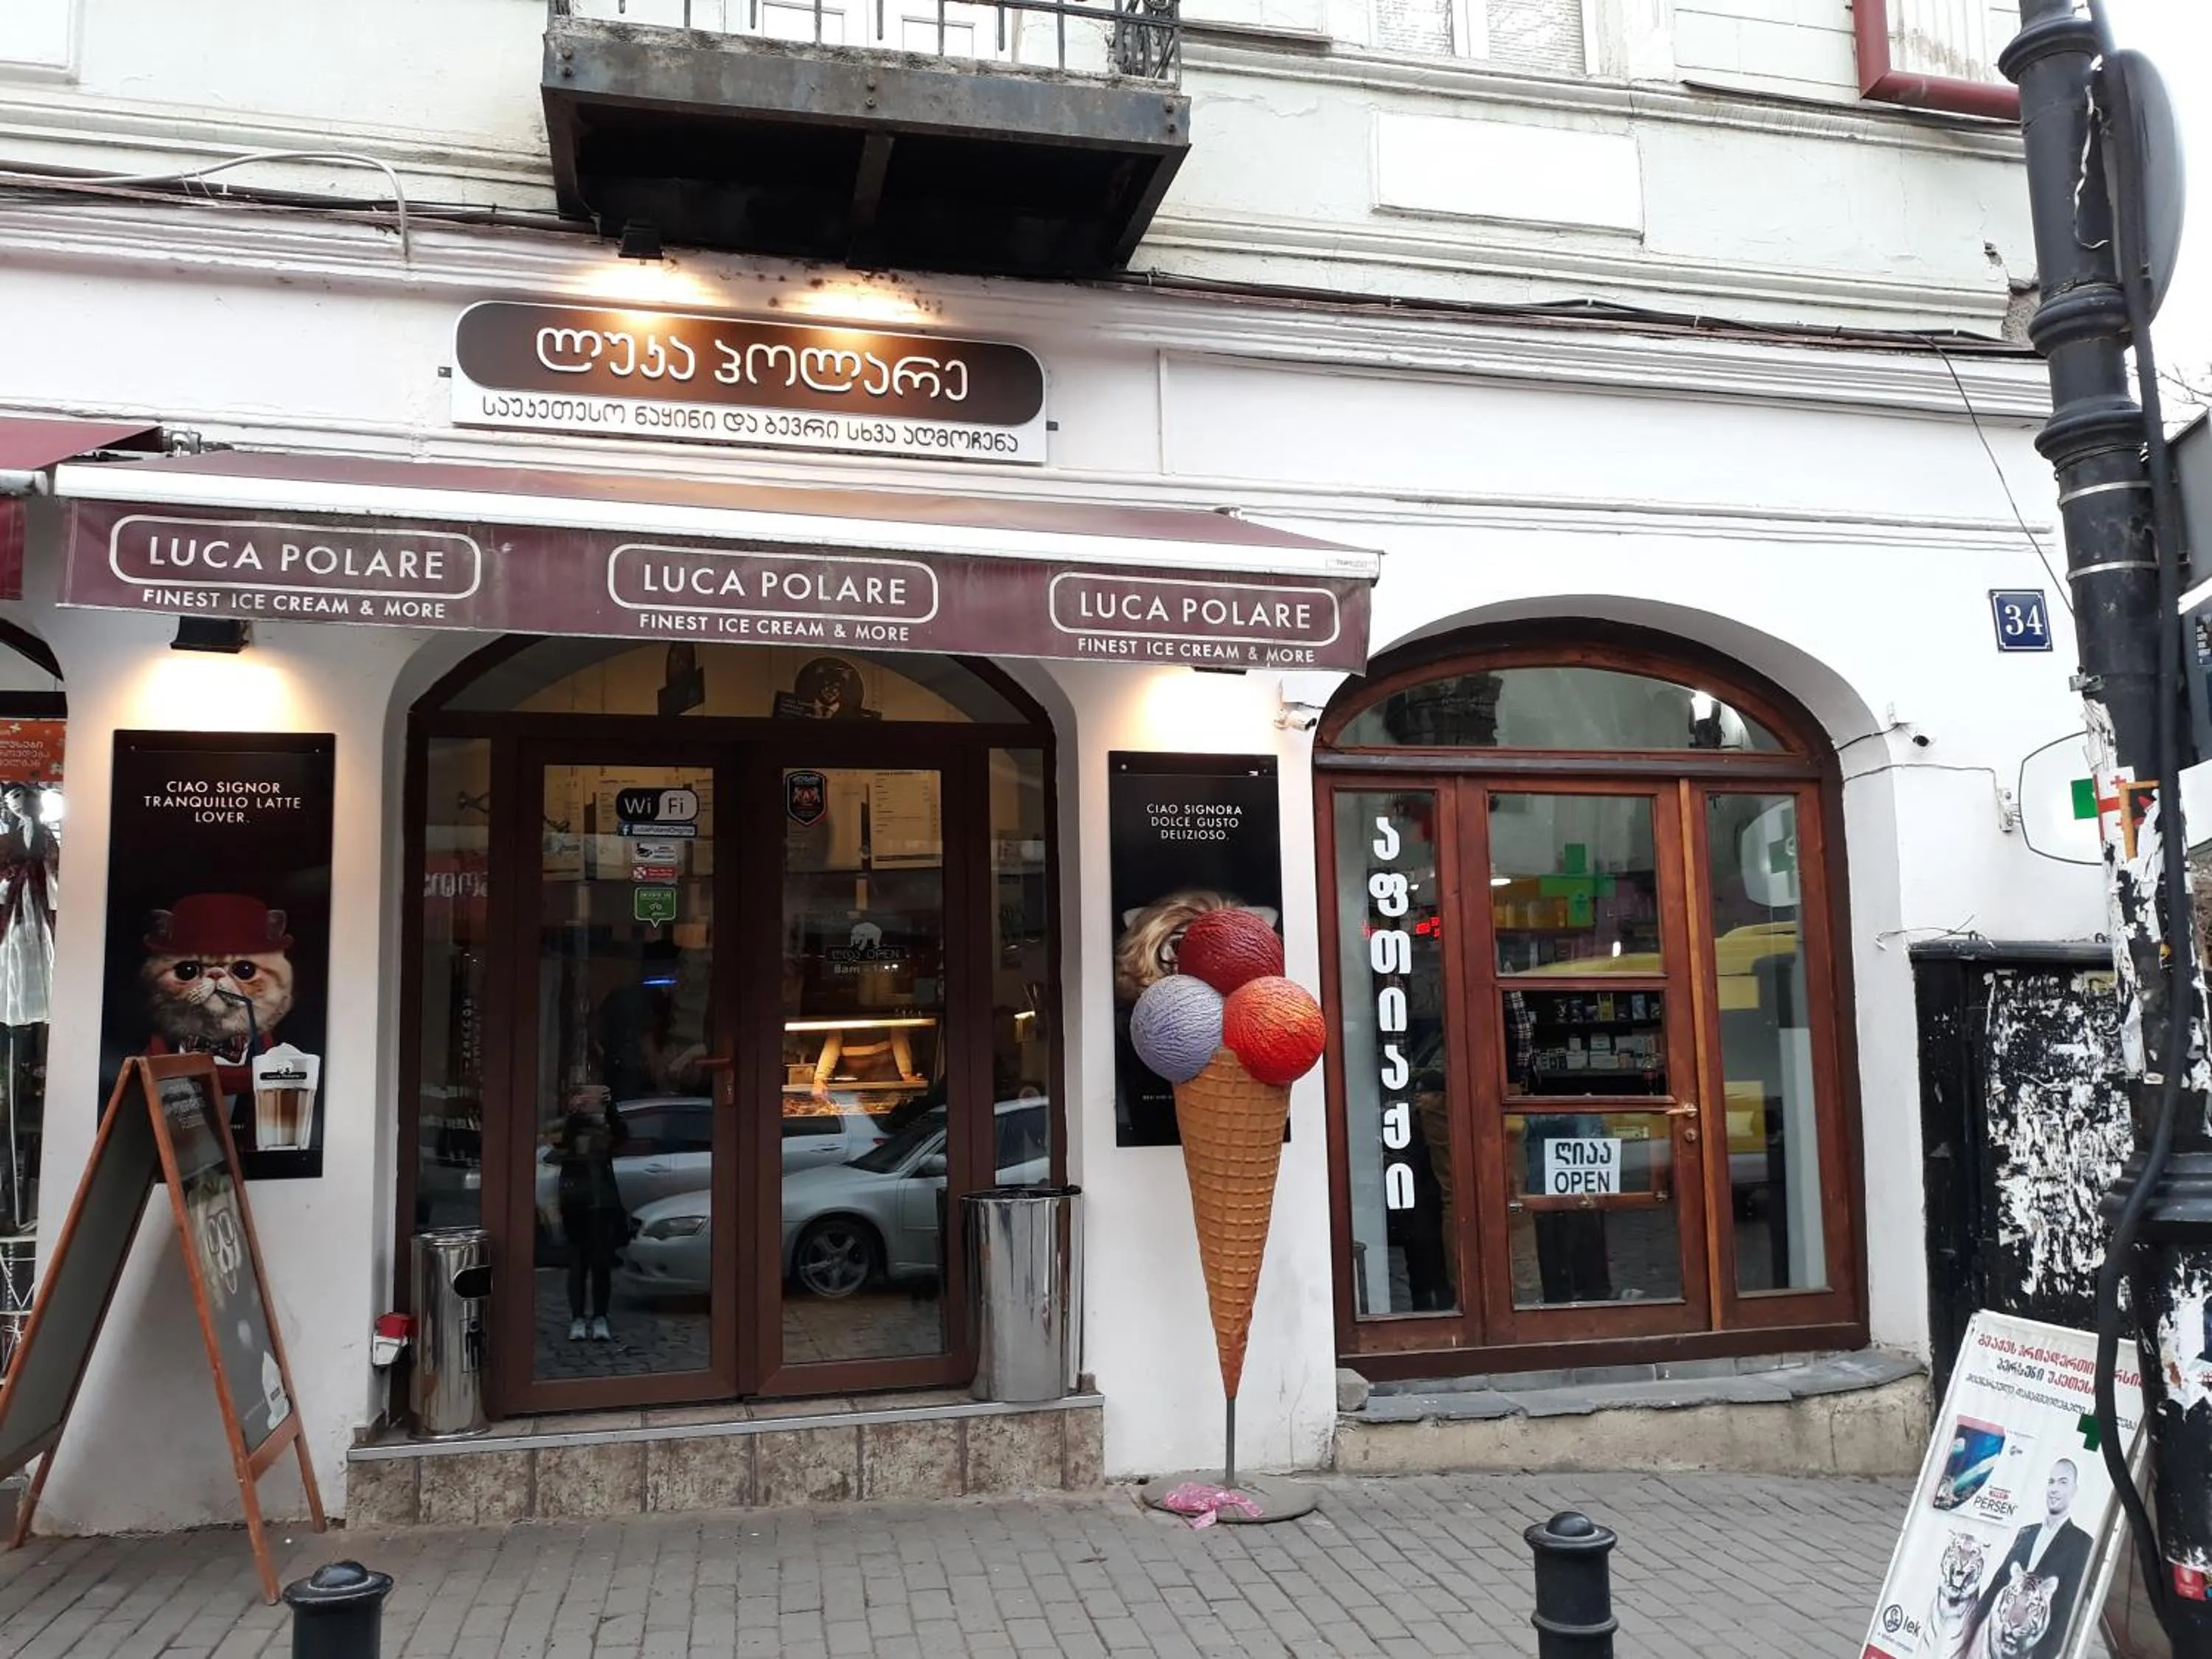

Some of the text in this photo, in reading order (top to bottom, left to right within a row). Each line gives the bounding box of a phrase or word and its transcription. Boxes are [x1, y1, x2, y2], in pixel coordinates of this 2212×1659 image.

[537, 327, 967, 400] ლუკა პოლარე
[483, 397, 1018, 452] საუკეთესო ნაყინი და ბევრი სხვა აღმოჩენა
[150, 537, 442, 579] LUCA POLARE
[644, 565, 905, 604] LUCA POLARE
[143, 589, 444, 618] FINEST ICE CREAM & MORE
[1081, 591, 1310, 628] LUCA POLARE
[640, 613, 908, 641] FINEST ICE CREAM & MORE
[2005, 605, 2042, 635] 34
[1079, 638, 1314, 662] FINEST ICE CREAM & MORE
[167, 782, 279, 793] CIAO SIGNOR
[145, 796, 300, 808] TRANQUILLO LATTE
[1147, 804, 1242, 815] CIAO SIGNORA
[195, 811, 251, 824] LOVER.
[1152, 817, 1239, 827] DOLCE GUSTO
[1161, 830, 1229, 841] DELIZIOSO.
[1368, 817, 1414, 1209] აფთიაქი
[1556, 1142, 1611, 1164] ღიაა
[1554, 1171, 1610, 1194] OPEN
[1903, 1615, 1921, 1638] lek
